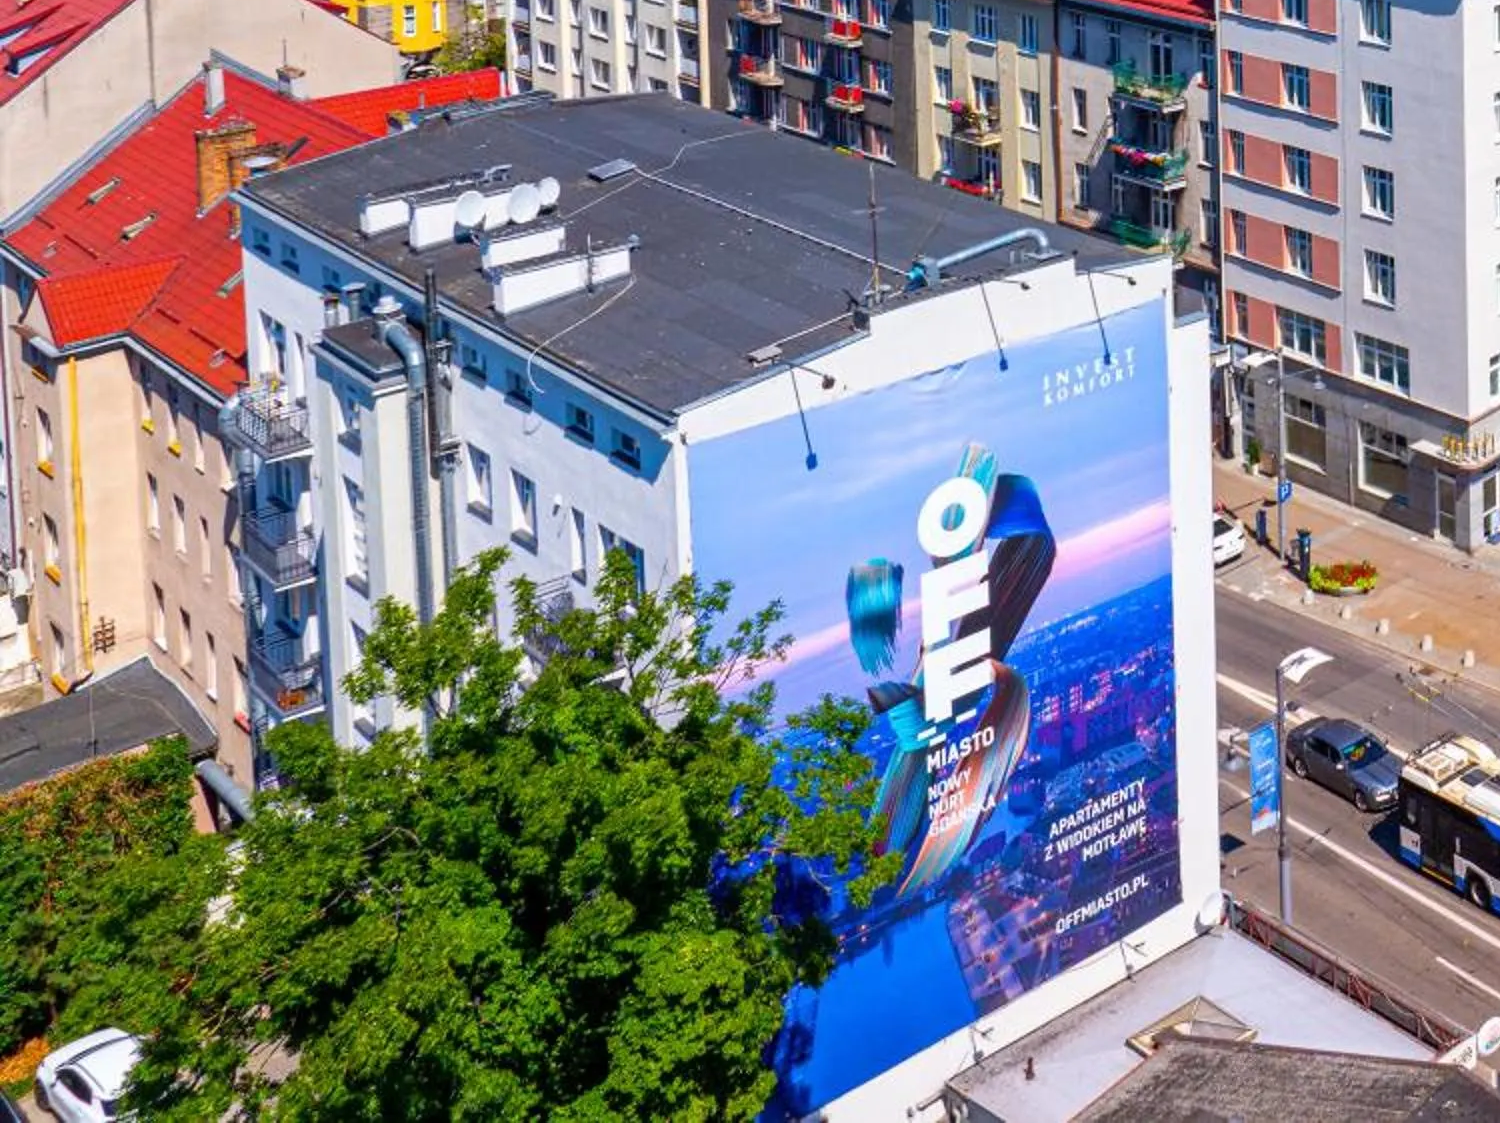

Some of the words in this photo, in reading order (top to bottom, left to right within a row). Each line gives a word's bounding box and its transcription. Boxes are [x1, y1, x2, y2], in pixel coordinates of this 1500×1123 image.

[1043, 346, 1135, 391] INVEST
[1043, 364, 1135, 408] KOMFORT
[917, 477, 994, 723] OFF
[927, 726, 995, 773] MIASTO
[928, 767, 972, 802] NOWY
[1050, 777, 1145, 839] APARTAMENTY
[1044, 842, 1054, 862] Z
[1056, 806, 1125, 854] WIDOKIEM
[1127, 797, 1146, 816] NA
[1055, 874, 1149, 934] OFFMIASTO.PL
